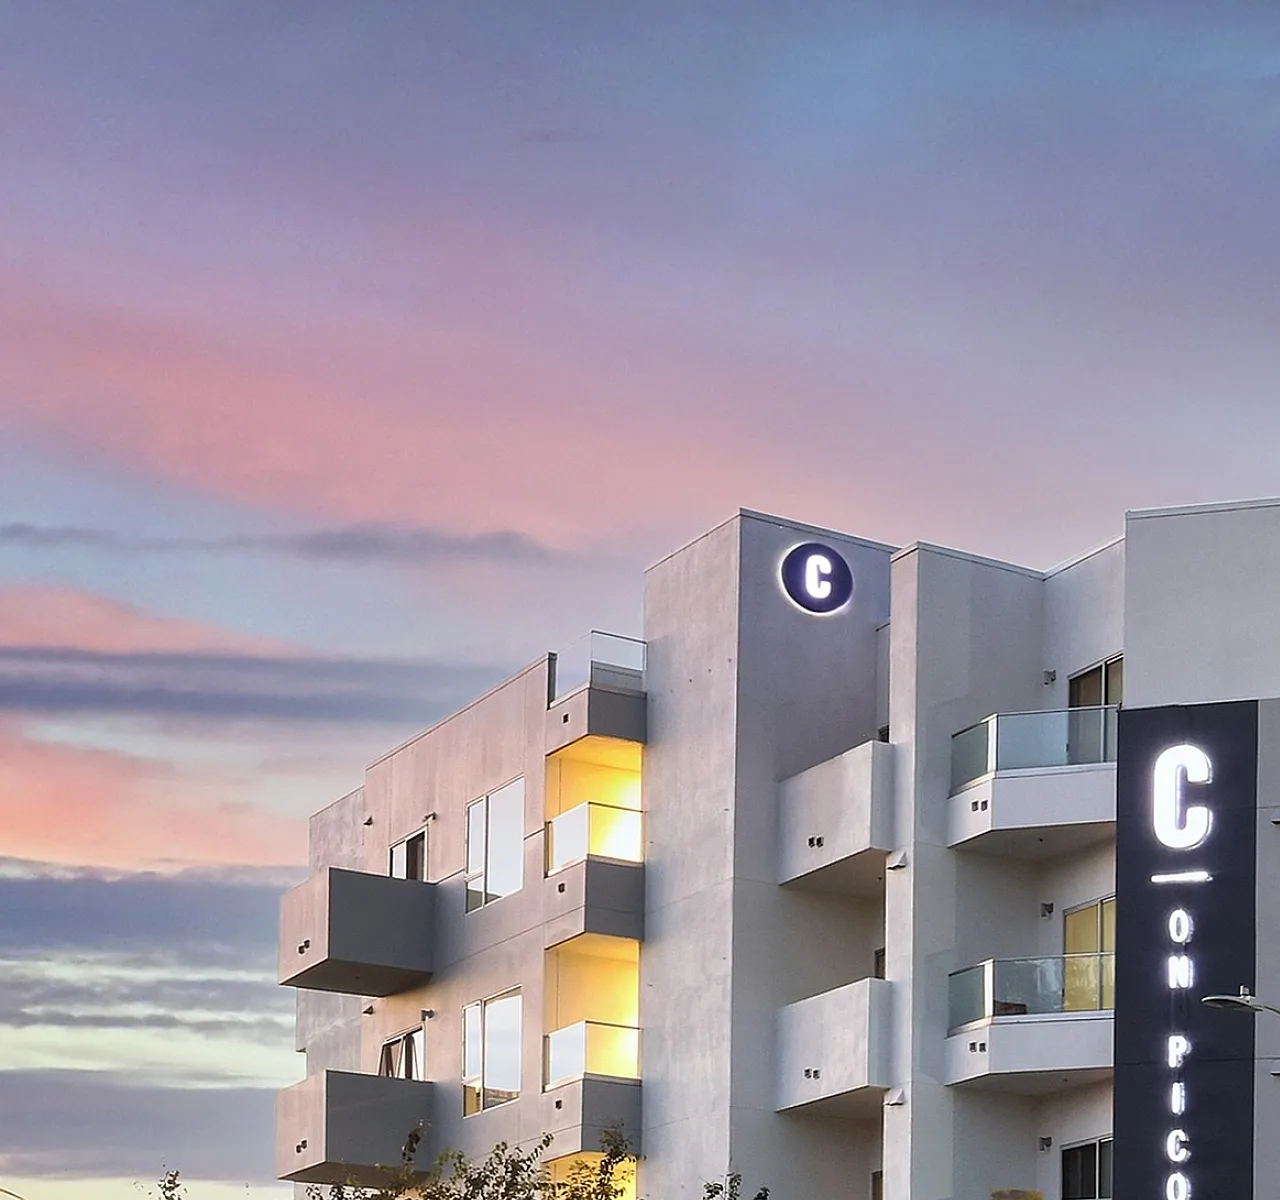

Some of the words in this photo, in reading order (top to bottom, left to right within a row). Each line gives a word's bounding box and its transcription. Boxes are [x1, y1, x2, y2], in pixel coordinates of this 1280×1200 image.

[806, 554, 832, 599] C
[1153, 744, 1213, 849] C
[1168, 908, 1193, 989] ON
